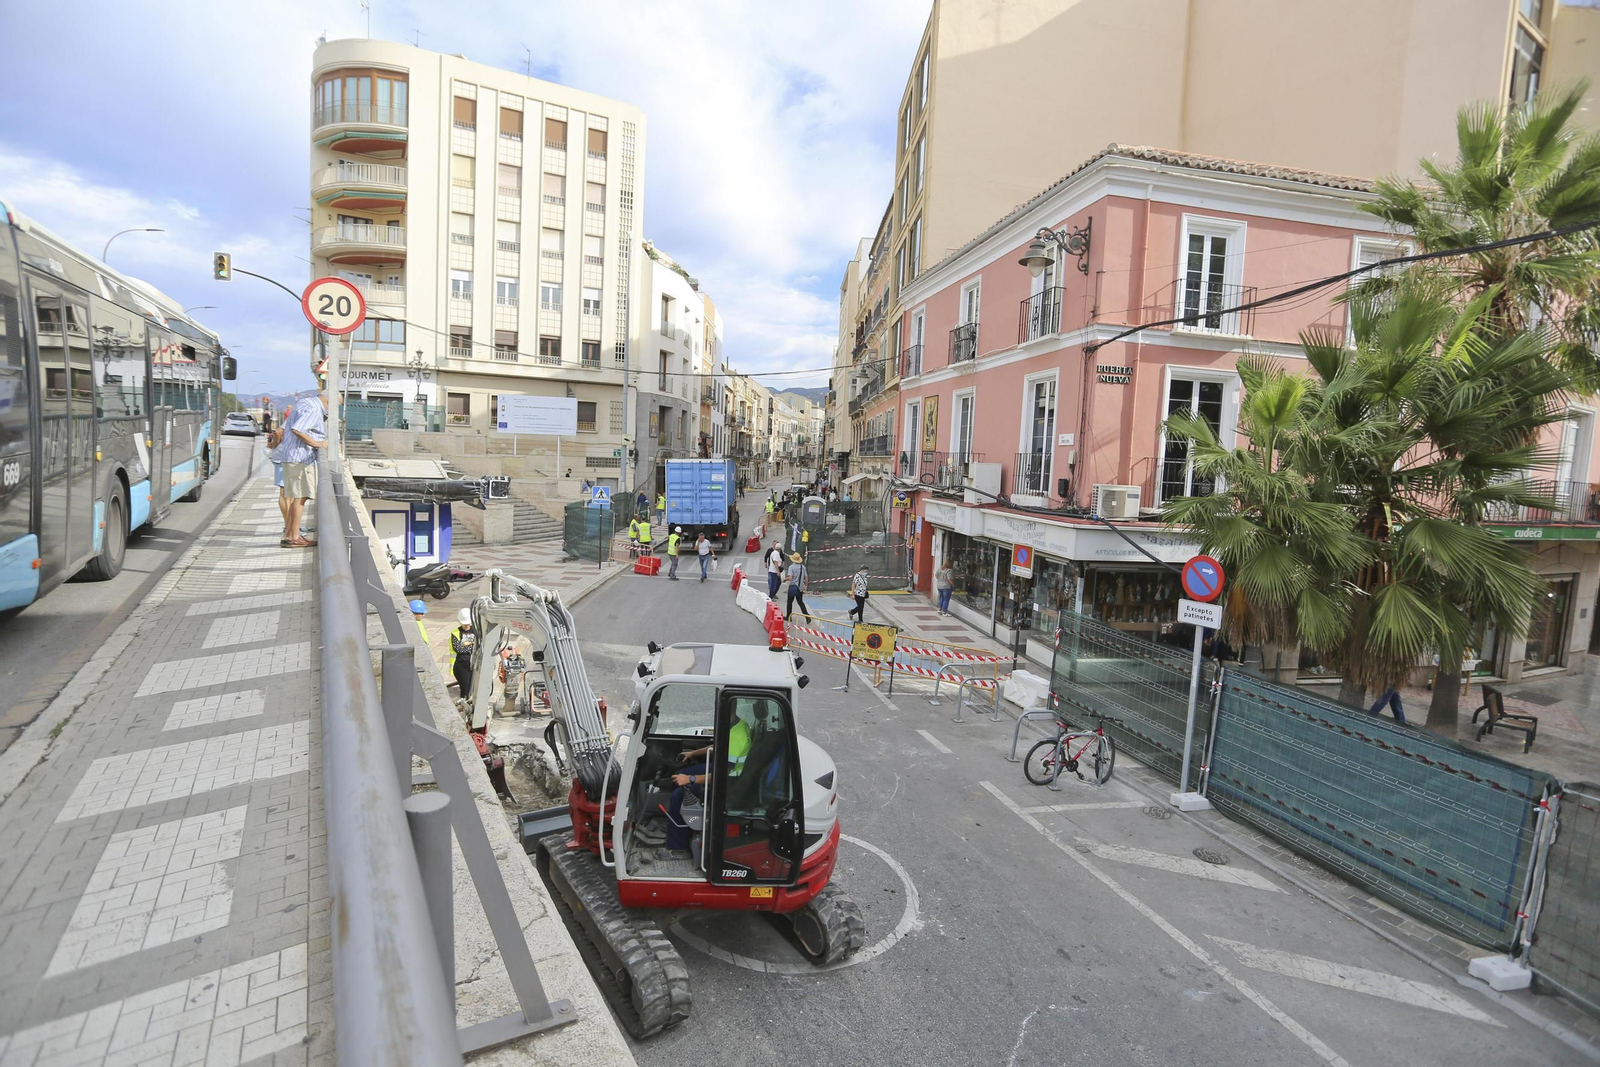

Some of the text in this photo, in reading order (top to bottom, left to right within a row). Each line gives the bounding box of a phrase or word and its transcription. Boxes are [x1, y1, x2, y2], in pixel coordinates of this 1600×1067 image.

[318, 294, 352, 317] 20
[341, 370, 393, 380] GOURMET
[1097, 365, 1133, 375] PUERTA
[1098, 375, 1131, 385] NUEVA
[4, 462, 20, 486] 669
[1514, 527, 1543, 538] cudeca
[1186, 605, 1213, 616] Excepto
[1183, 612, 1214, 622] patinetes
[722, 869, 748, 878] TB260
